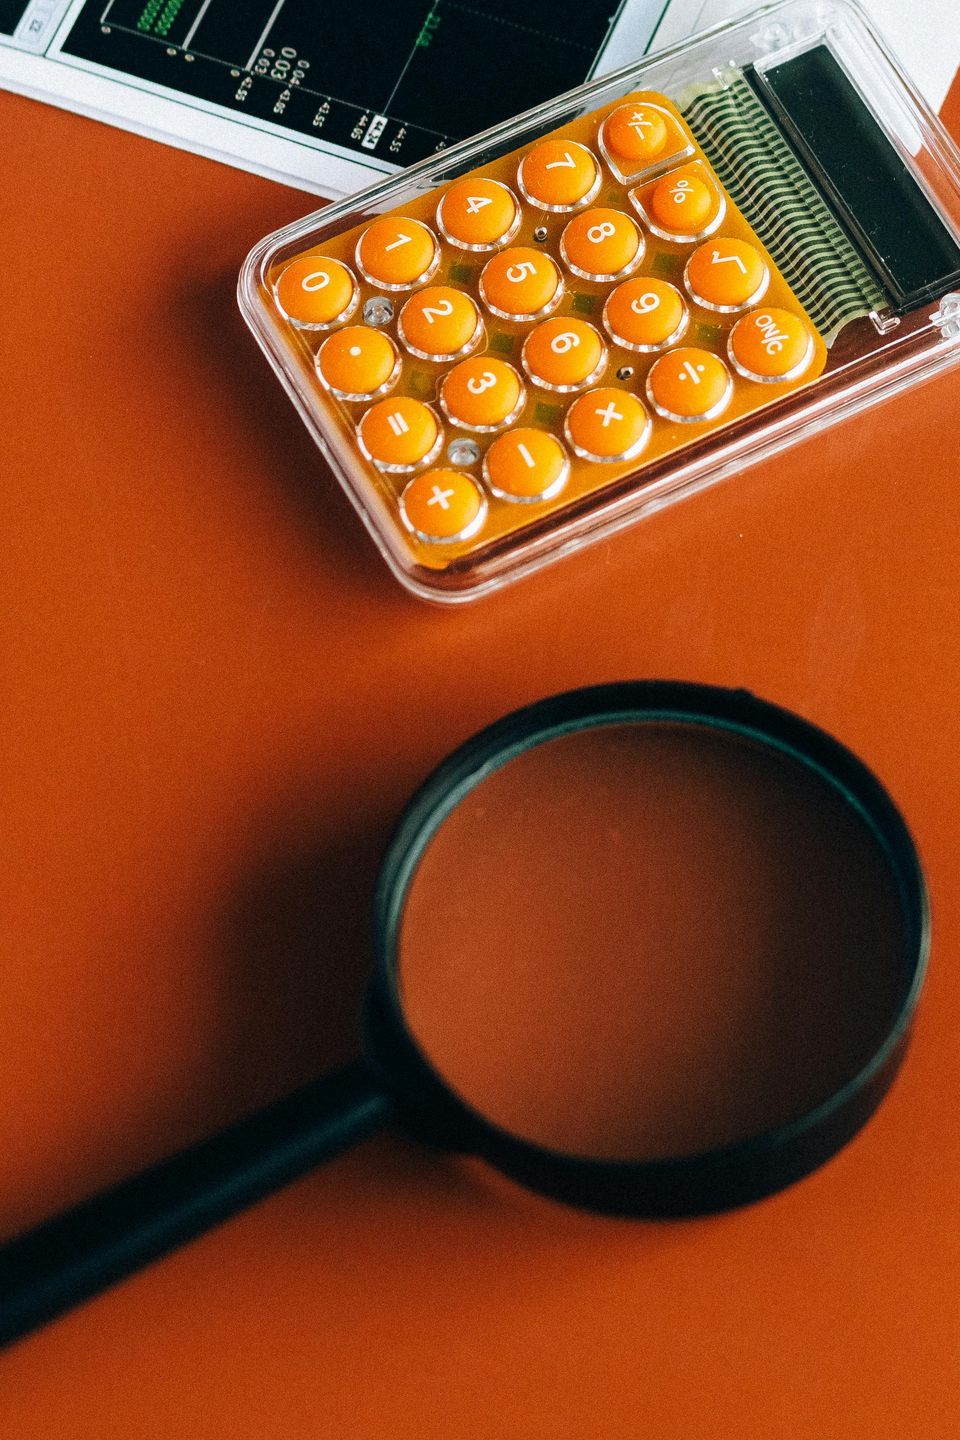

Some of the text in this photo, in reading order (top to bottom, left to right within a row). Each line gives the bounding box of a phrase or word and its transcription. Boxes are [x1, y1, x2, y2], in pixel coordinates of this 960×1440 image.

[385, 233, 412, 252] 1
[422, 299, 454, 324] 2
[467, 371, 497, 395] 3
[466, 196, 493, 214] 4
[506, 261, 537, 283] 5
[550, 331, 581, 354] 6
[545, 152, 576, 170] 7
[587, 222, 616, 244] 8
[631, 292, 660, 315] 9
[668, 178, 694, 204] %
[755, 314, 789, 355] ON/C
[301, 271, 331, 292] 0
[427, 485, 455, 510] +
